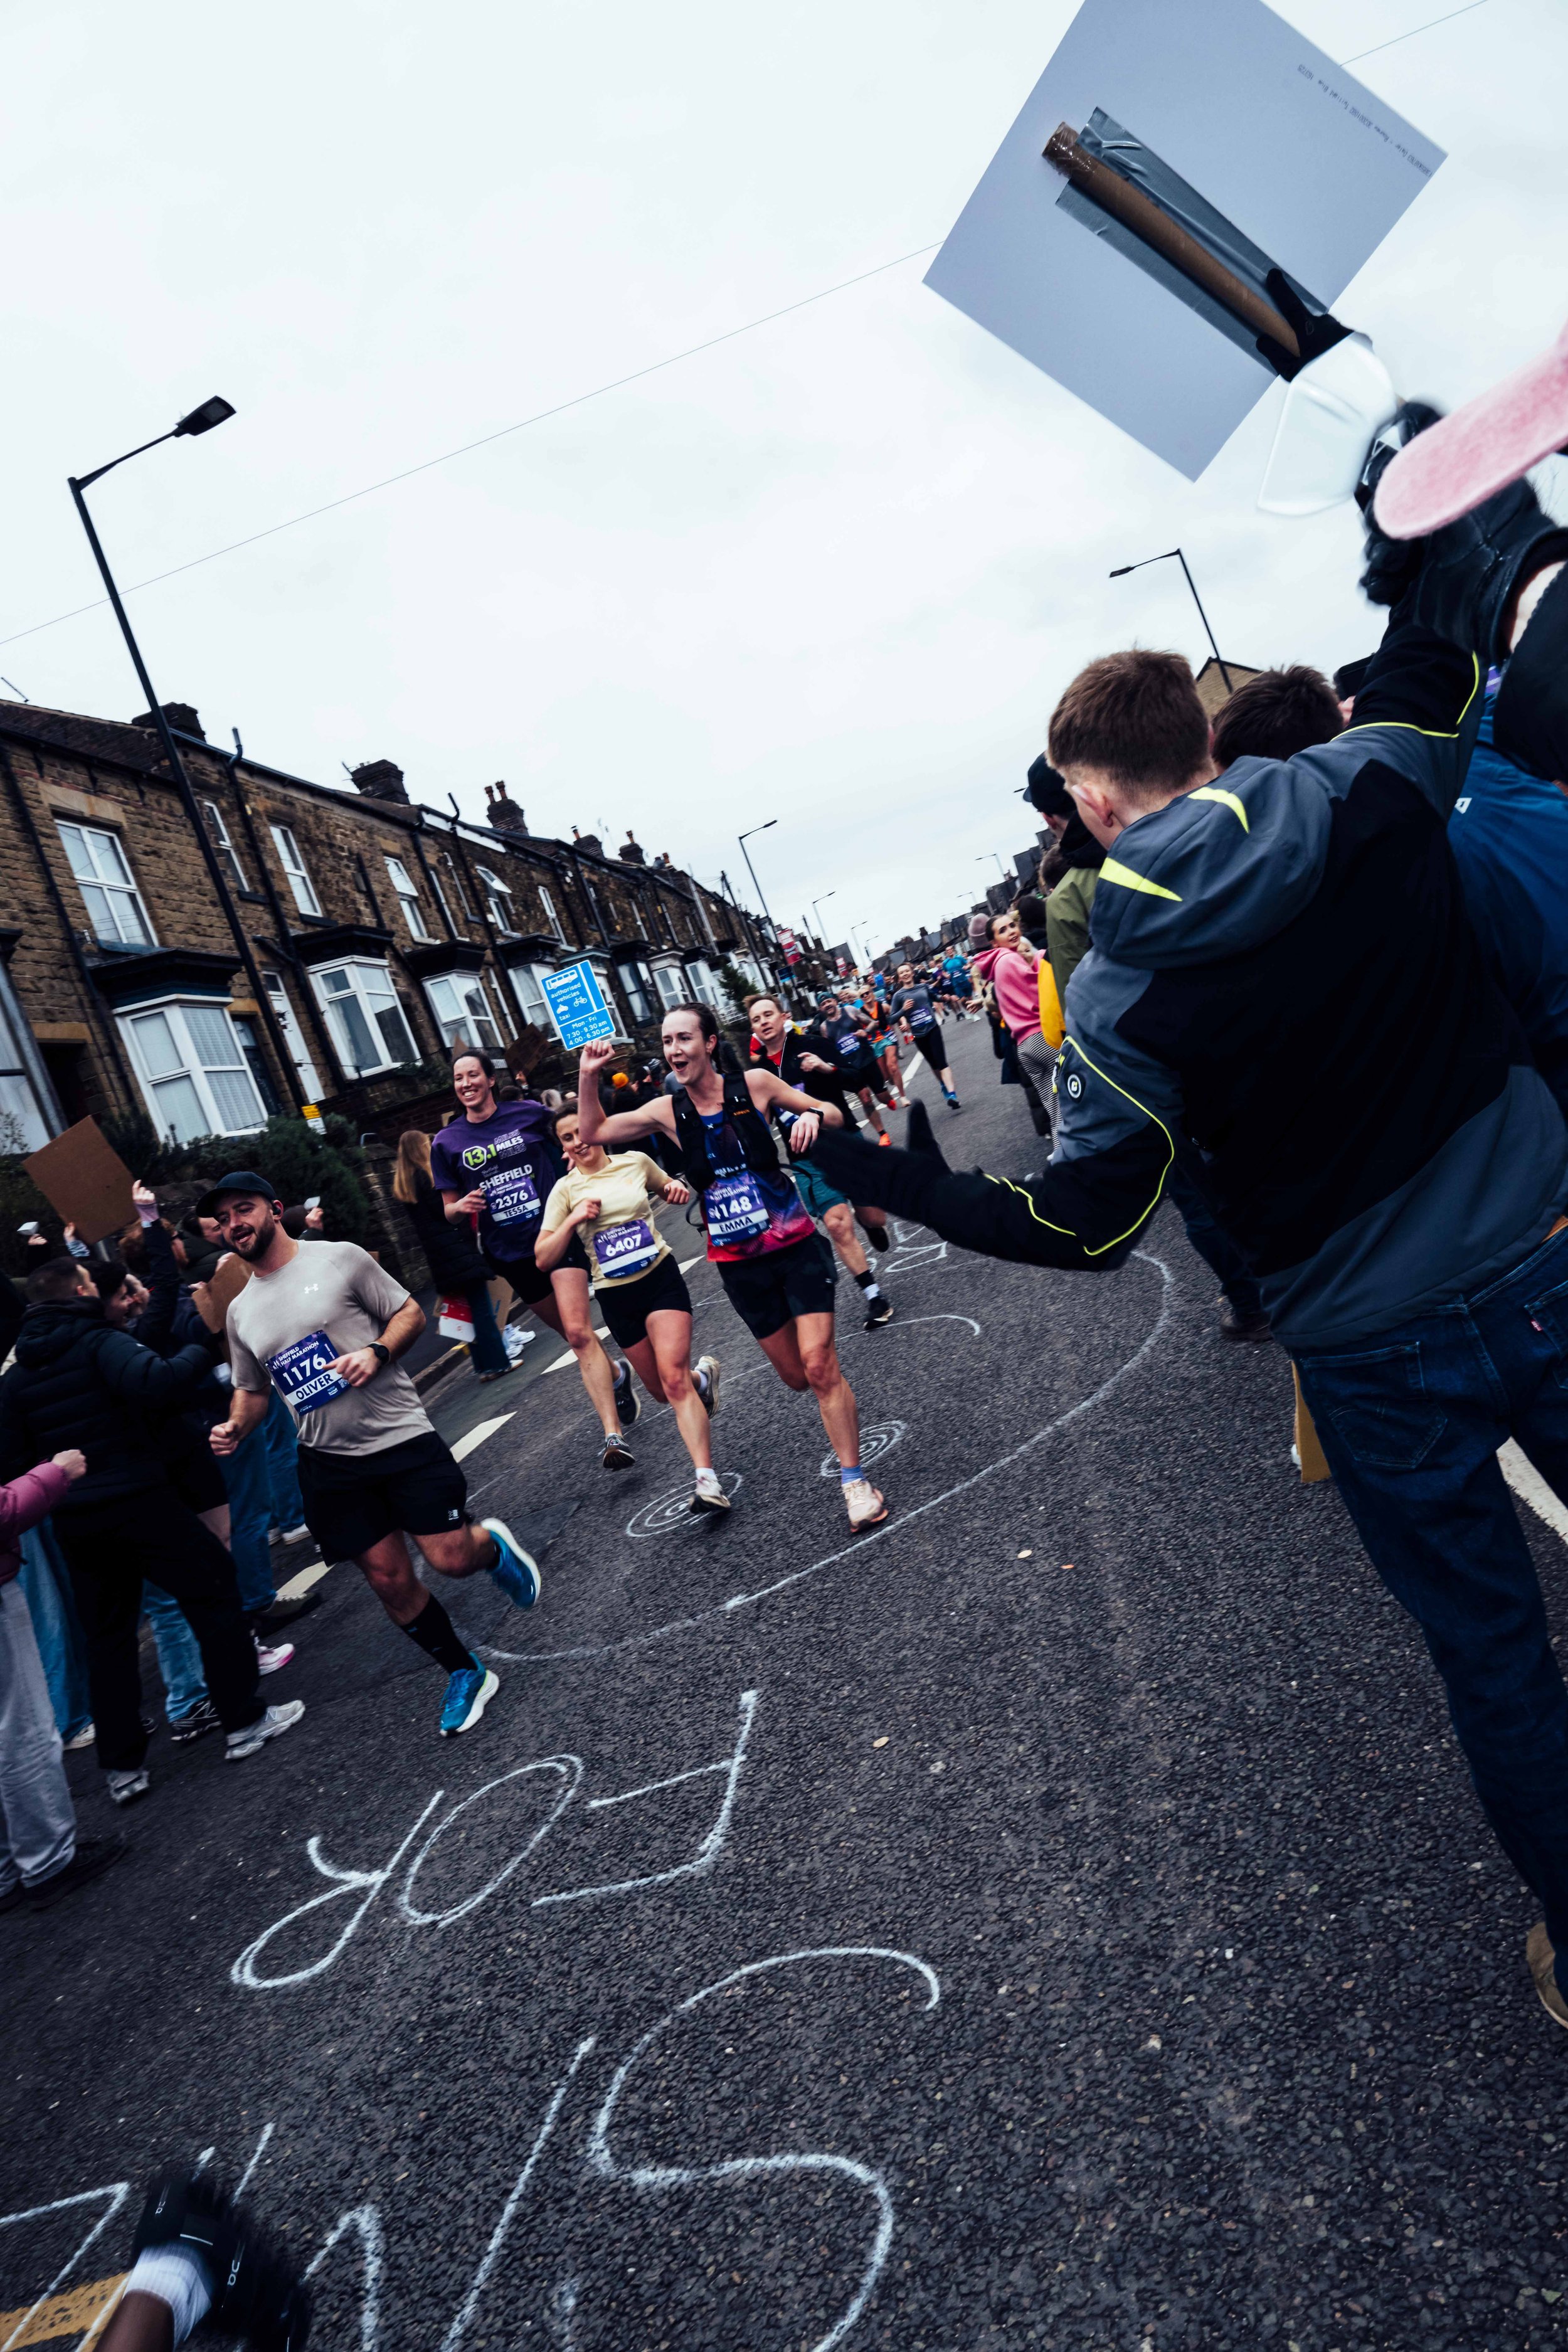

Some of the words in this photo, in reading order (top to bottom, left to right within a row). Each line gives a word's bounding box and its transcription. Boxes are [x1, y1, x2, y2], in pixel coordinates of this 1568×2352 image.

[551, 982, 581, 999] authorised
[556, 991, 580, 1003] vehicles
[559, 1012, 571, 1021] taxi
[571, 1021, 585, 1029] Mon
[566, 1030, 580, 1039] 7.30
[583, 1023, 598, 1032] 9.30
[569, 1036, 583, 1046] 4.00
[586, 1029, 600, 1039] 6.30
[601, 1026, 610, 1034] pm
[497, 1136, 524, 1152] MILES
[479, 1164, 532, 1192] SHEFFIELD
[495, 1190, 529, 1210] 2376
[503, 1205, 529, 1218] TESSA
[719, 1216, 753, 1233] EMMA
[606, 1234, 642, 1257] 6407
[278, 1347, 300, 1362] SHEFFIELD
[280, 1357, 292, 1366] HALF
[291, 1340, 319, 1360] MARATHON
[282, 1353, 327, 1387] 1176
[295, 1373, 334, 1401] OLIVER
[230, 1689, 760, 1989] FOR
